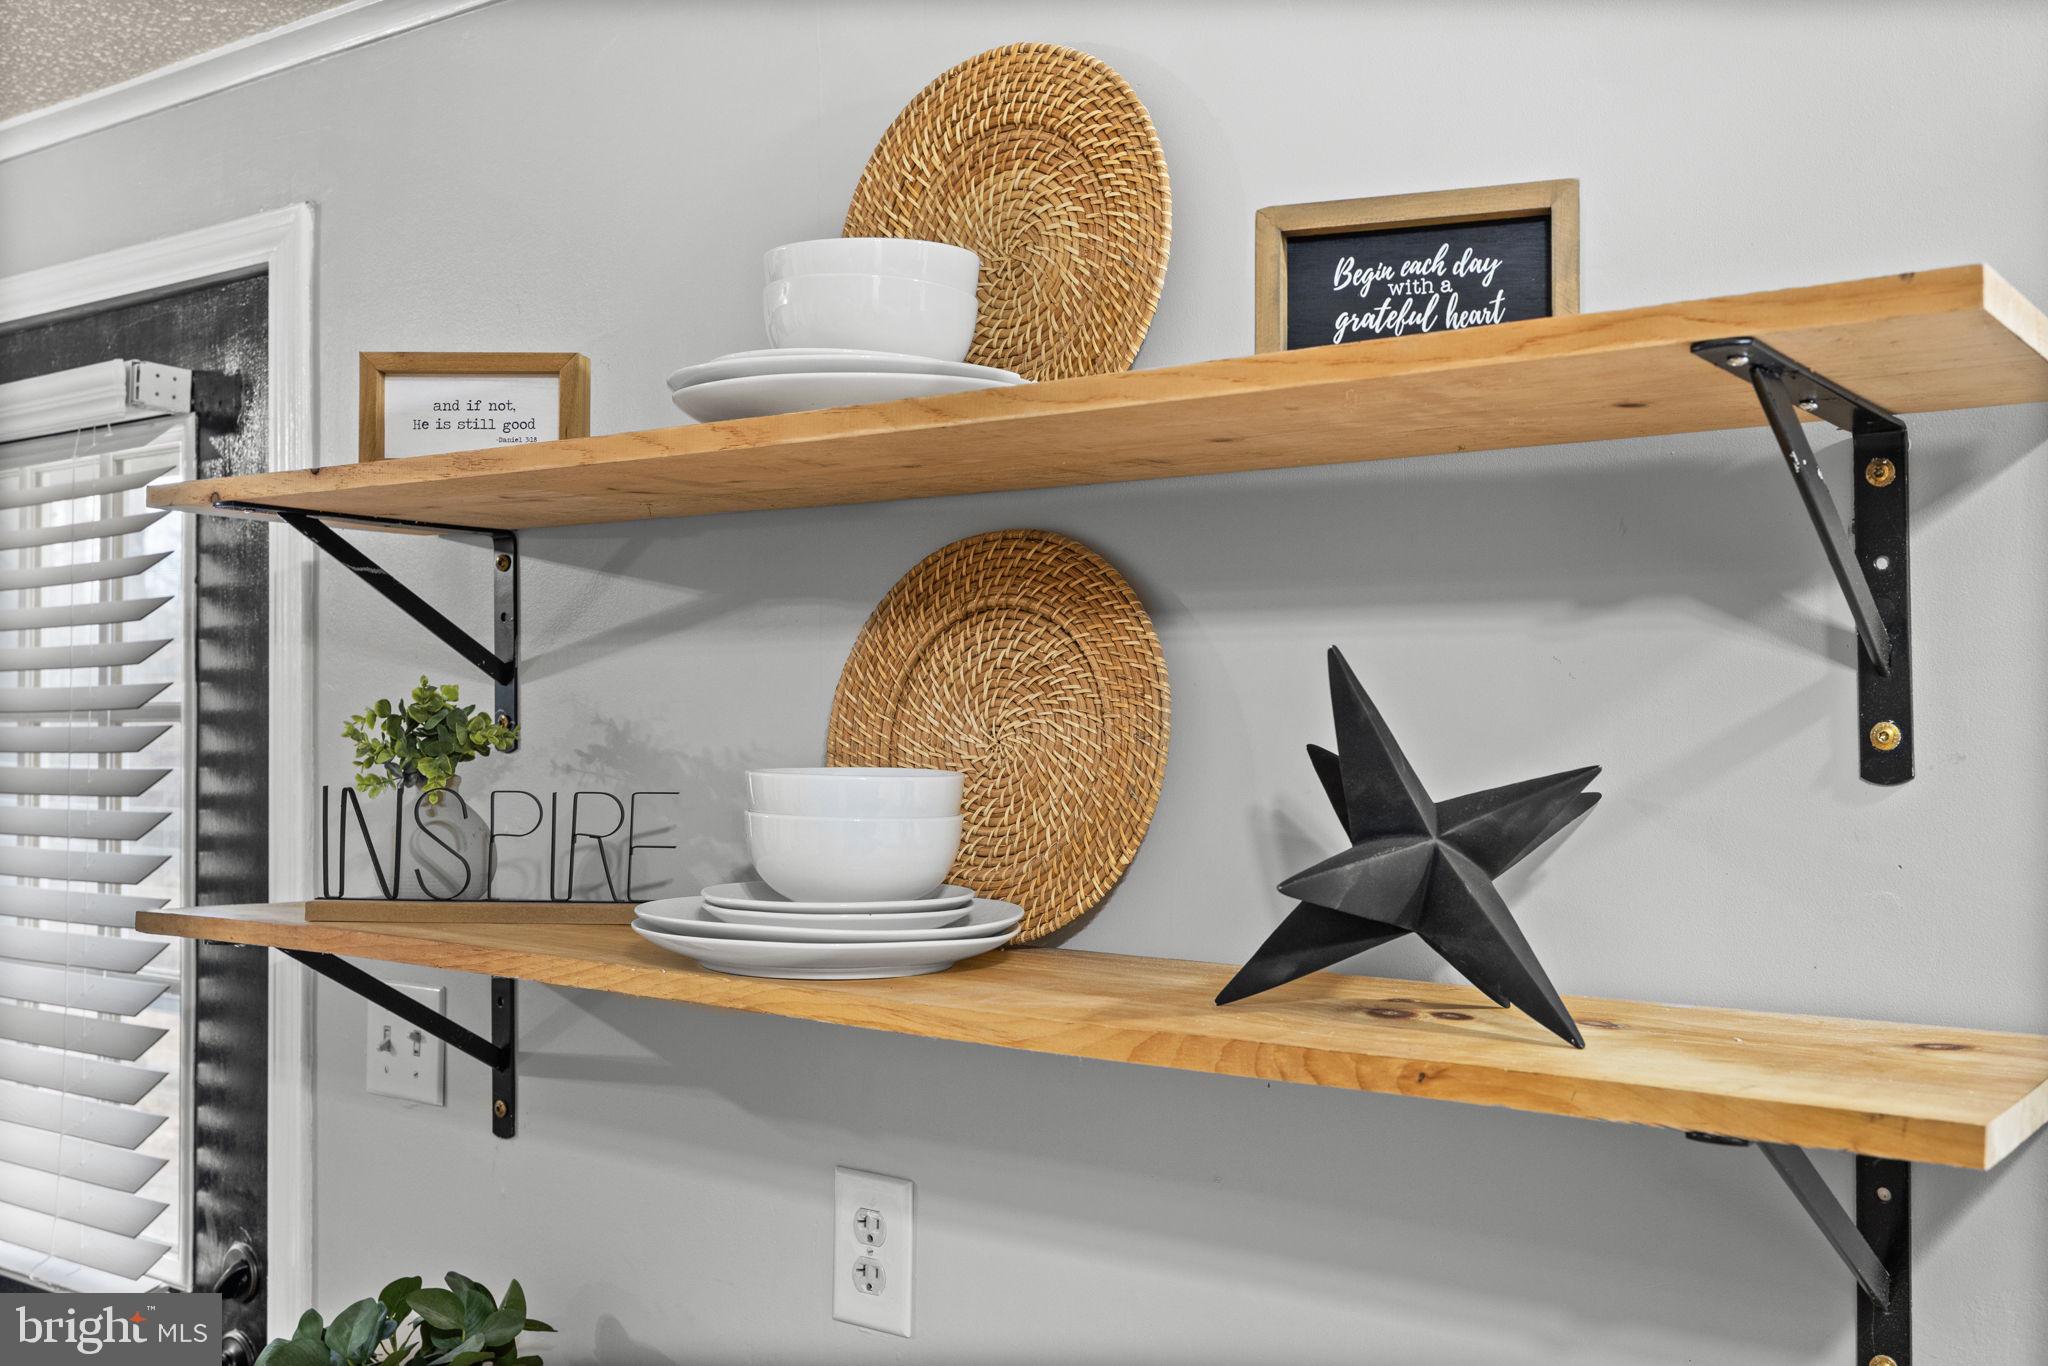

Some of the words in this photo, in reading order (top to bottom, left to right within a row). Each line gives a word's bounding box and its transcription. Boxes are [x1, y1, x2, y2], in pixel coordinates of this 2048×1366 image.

[1333, 256, 1395, 298] Begin
[1400, 243, 1449, 277] each
[1452, 247, 1503, 287] day
[1387, 277, 1435, 296] with
[1440, 278, 1453, 293] a
[1333, 294, 1439, 344] grateful
[1445, 289, 1506, 330] heart
[433, 399, 460, 412] and
[466, 399, 482, 412] if
[488, 399, 517, 413] not,
[412, 418, 430, 431] He
[436, 418, 452, 430] is
[457, 418, 497, 430] still
[502, 418, 536, 433] good
[322, 785, 680, 902] INSPIRE
